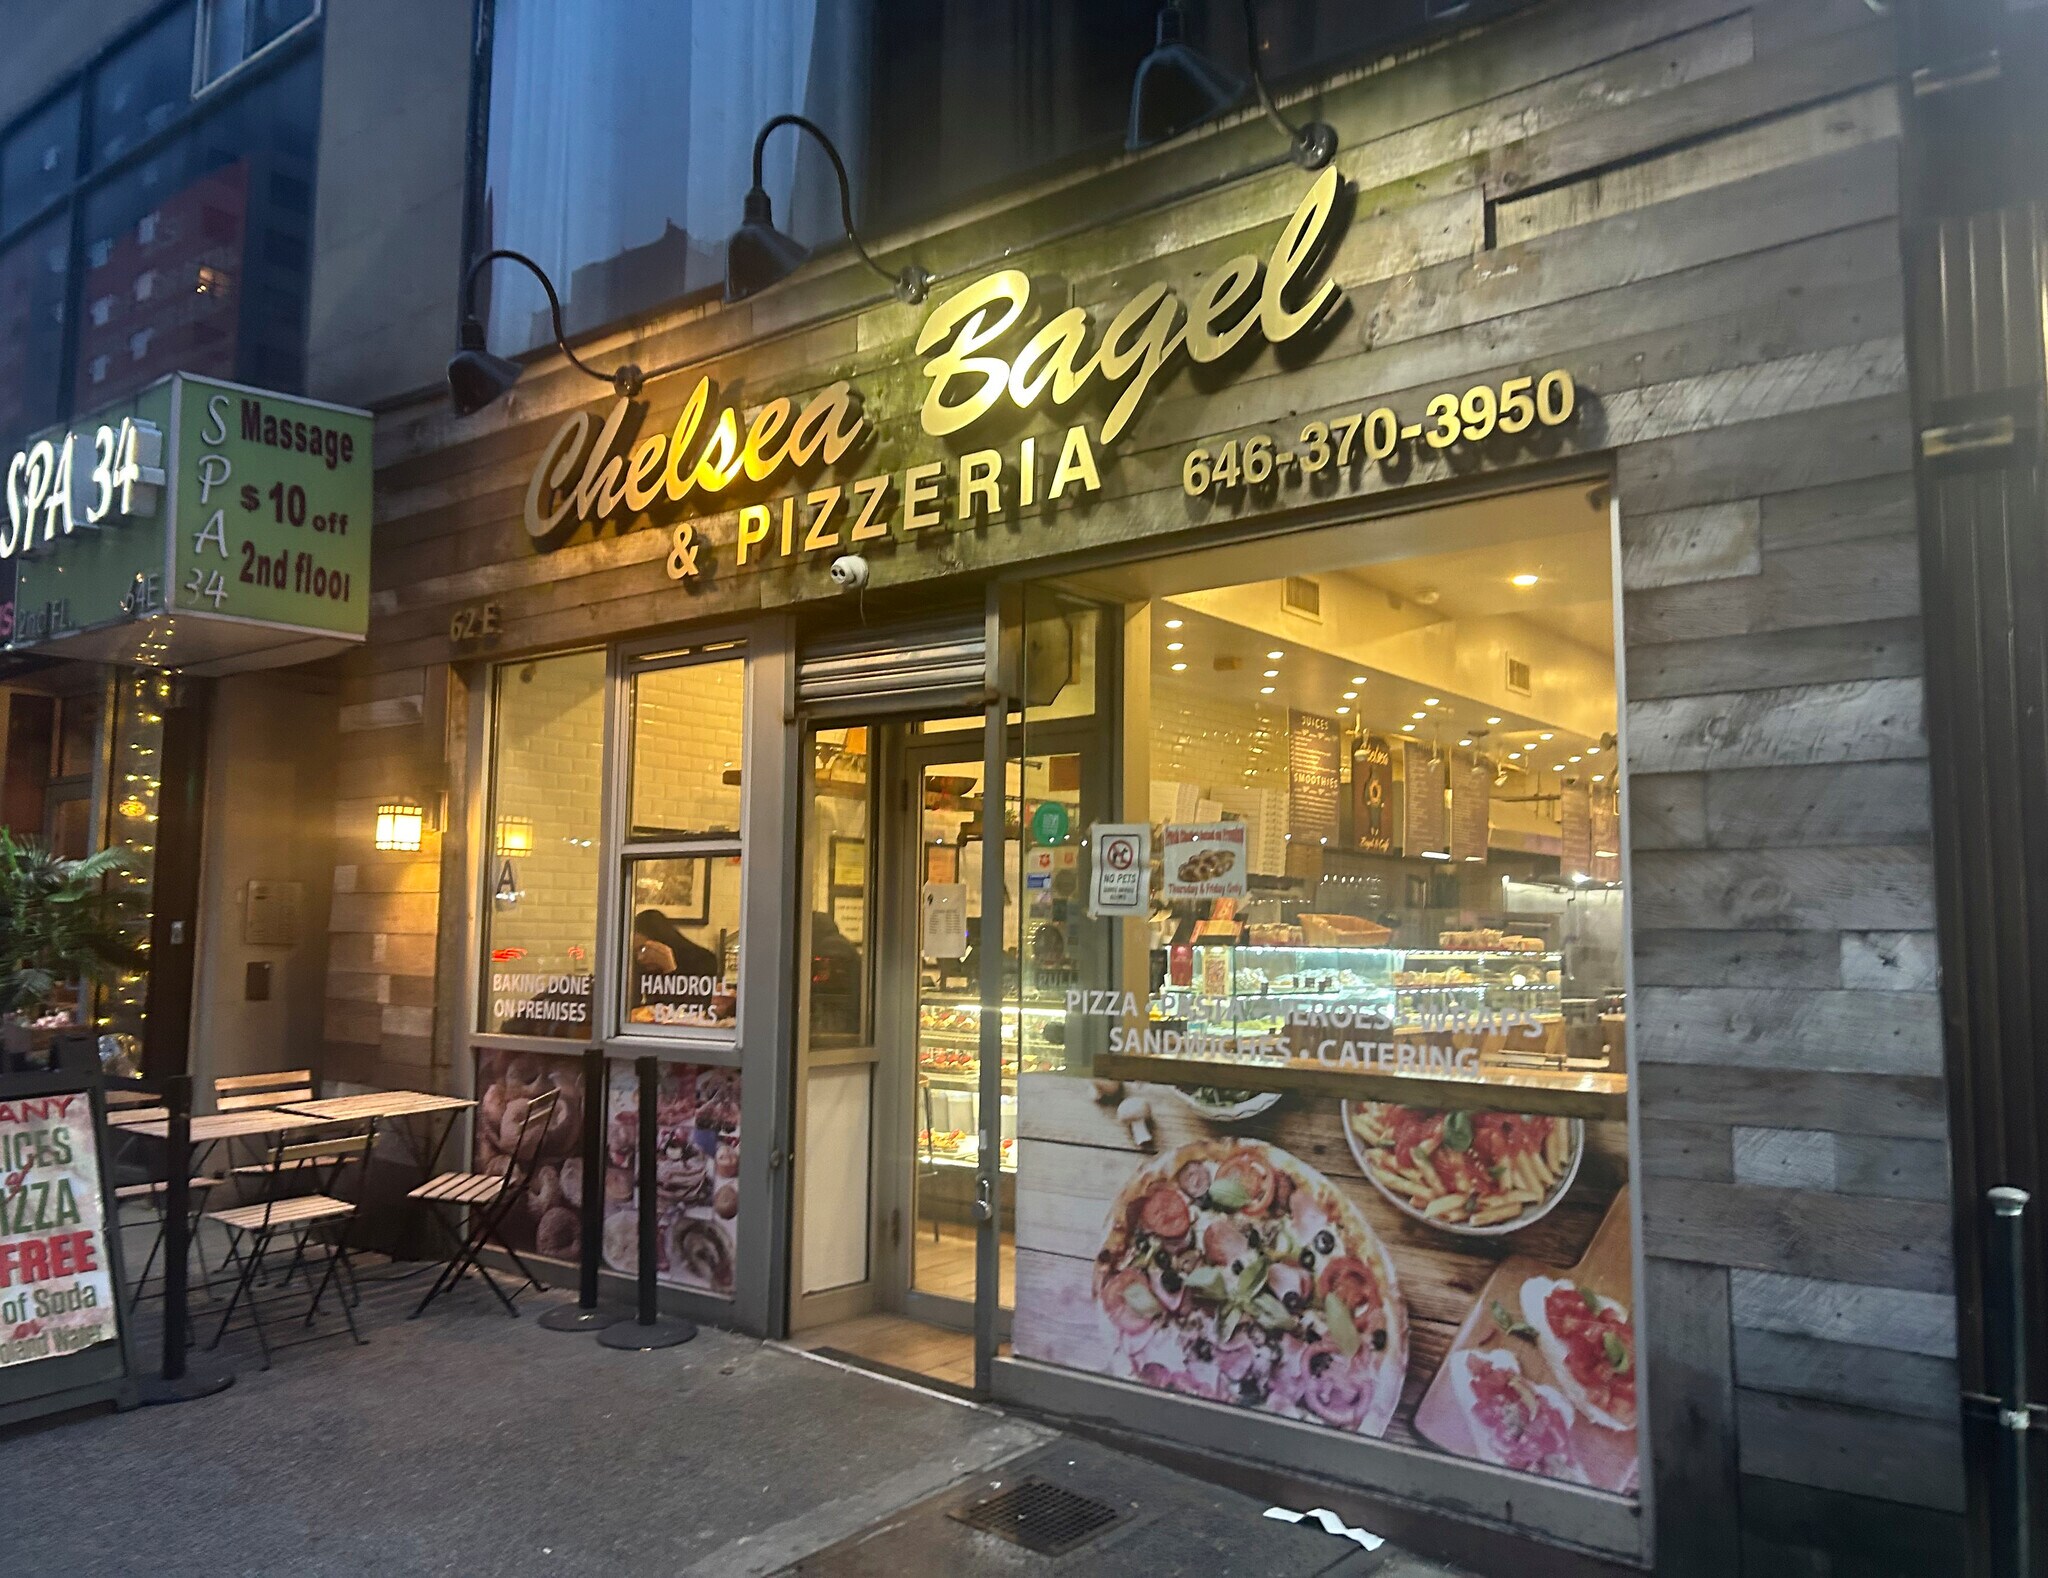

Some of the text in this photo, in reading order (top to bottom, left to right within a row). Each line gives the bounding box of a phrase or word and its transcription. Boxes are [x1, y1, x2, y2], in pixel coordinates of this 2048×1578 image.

[524, 165, 1342, 539] Chelsea Bagel
[241, 400, 354, 470] Massage
[1182, 369, 1575, 498] 646-370-3950
[0, 416, 140, 559] SPA 34
[667, 426, 1102, 581] & PIZZERIA
[312, 511, 349, 536] off
[239, 540, 289, 590] 2nd
[186, 568, 229, 608] 34
[450, 608, 476, 642] 62
[1302, 715, 1329, 730] JUICES
[1293, 773, 1338, 789] SMOOTHIES
[496, 859, 516, 902] A
[1104, 873, 1136, 884] NO PETS
[493, 973, 590, 996] BAKING DONE
[641, 973, 731, 997] HANDROLL
[494, 999, 587, 1023] ON PREMISES
[655, 1002, 718, 1025] BAGELS
[1066, 989, 1544, 1038] PIZZA PASTA HEROES WRAPS
[1110, 1026, 1480, 1078] SANDWICHES CATERING
[0, 1094, 75, 1124] ANY
[0, 1127, 72, 1173] ICES
[0, 1177, 81, 1236] IZZA
[0, 1230, 98, 1288] FREE
[3, 1282, 97, 1325] of Soda
